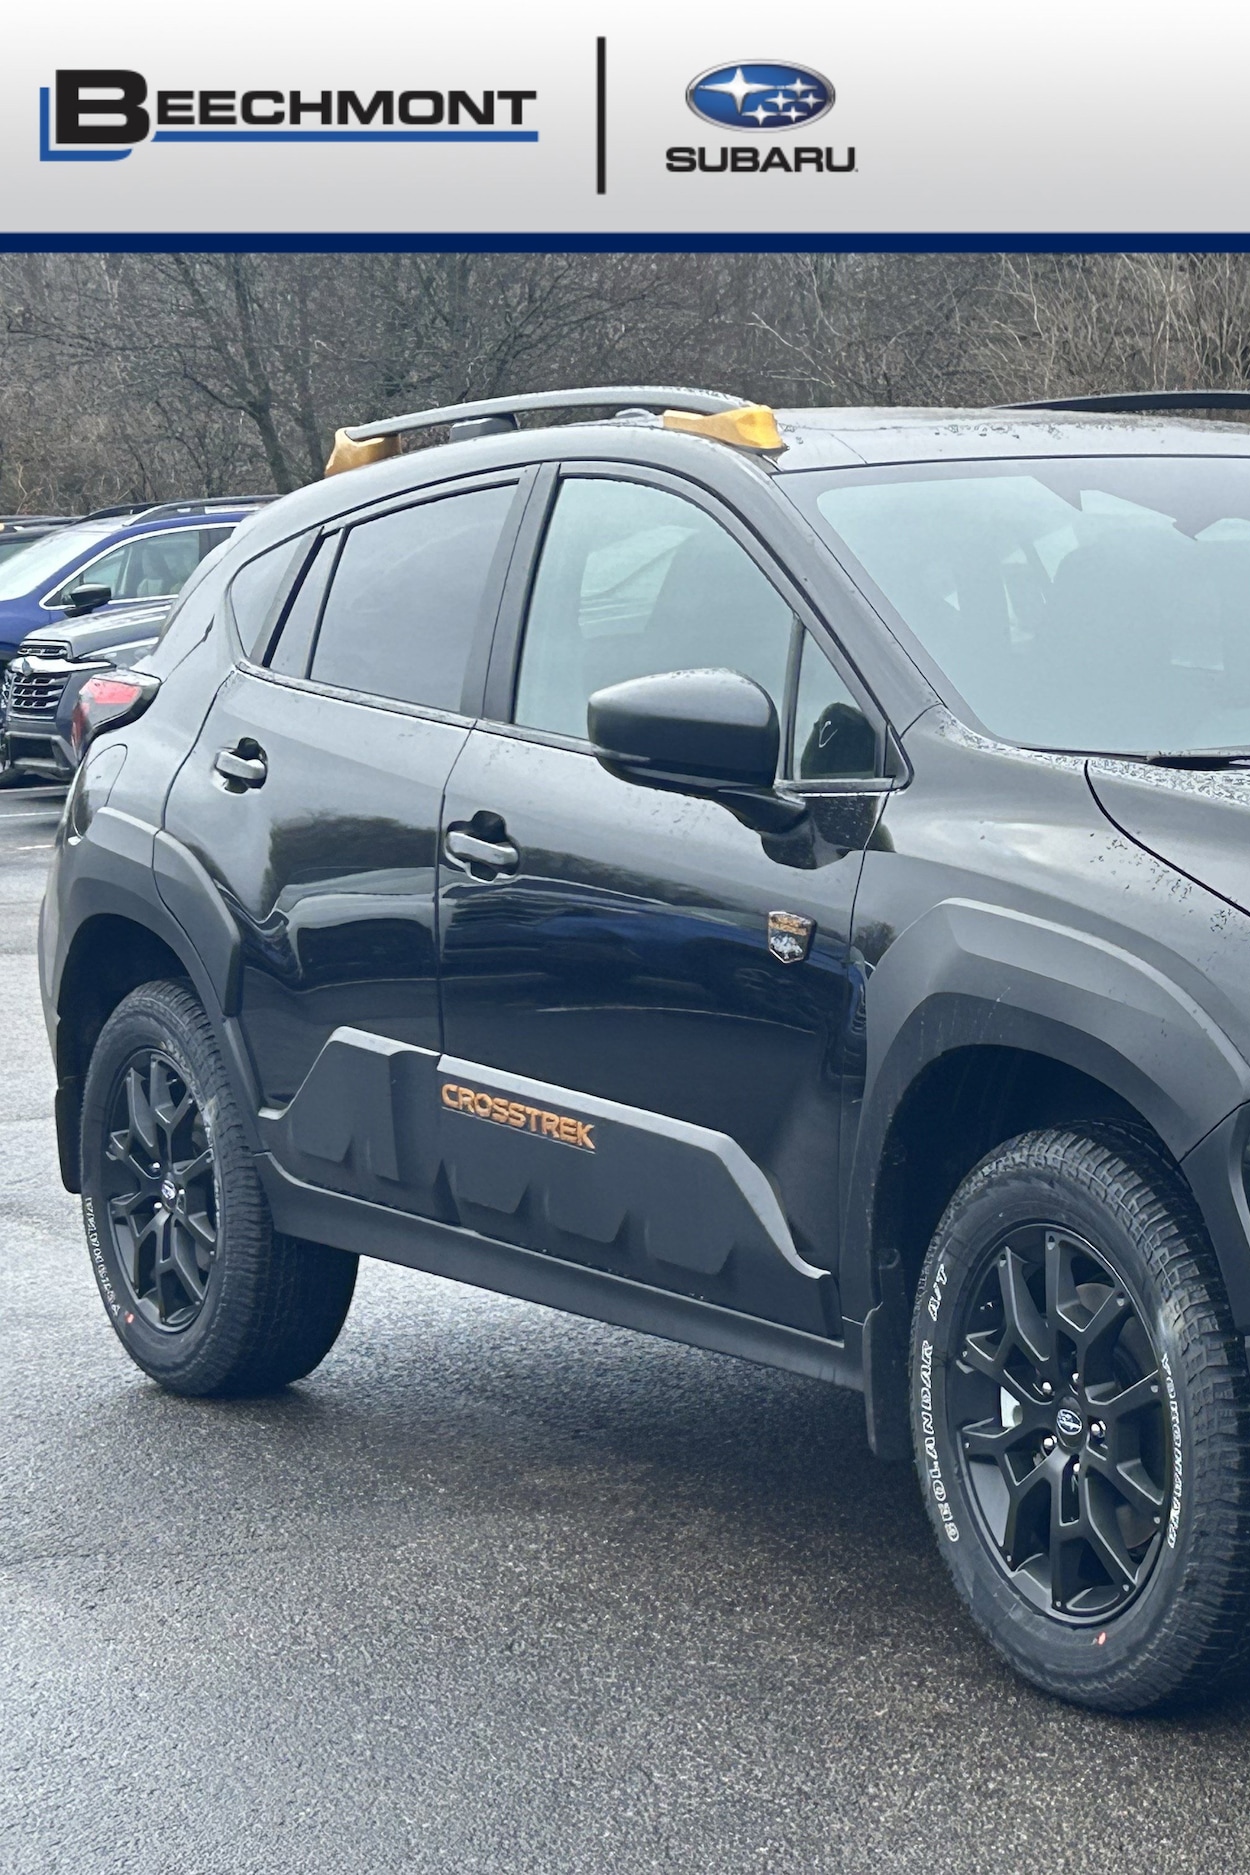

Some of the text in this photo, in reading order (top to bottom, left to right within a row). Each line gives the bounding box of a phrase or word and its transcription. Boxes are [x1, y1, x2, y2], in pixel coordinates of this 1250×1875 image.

[441, 1083, 596, 1149] CROSSTREK
[920, 1263, 960, 1543] GEOLANDAR A/T
